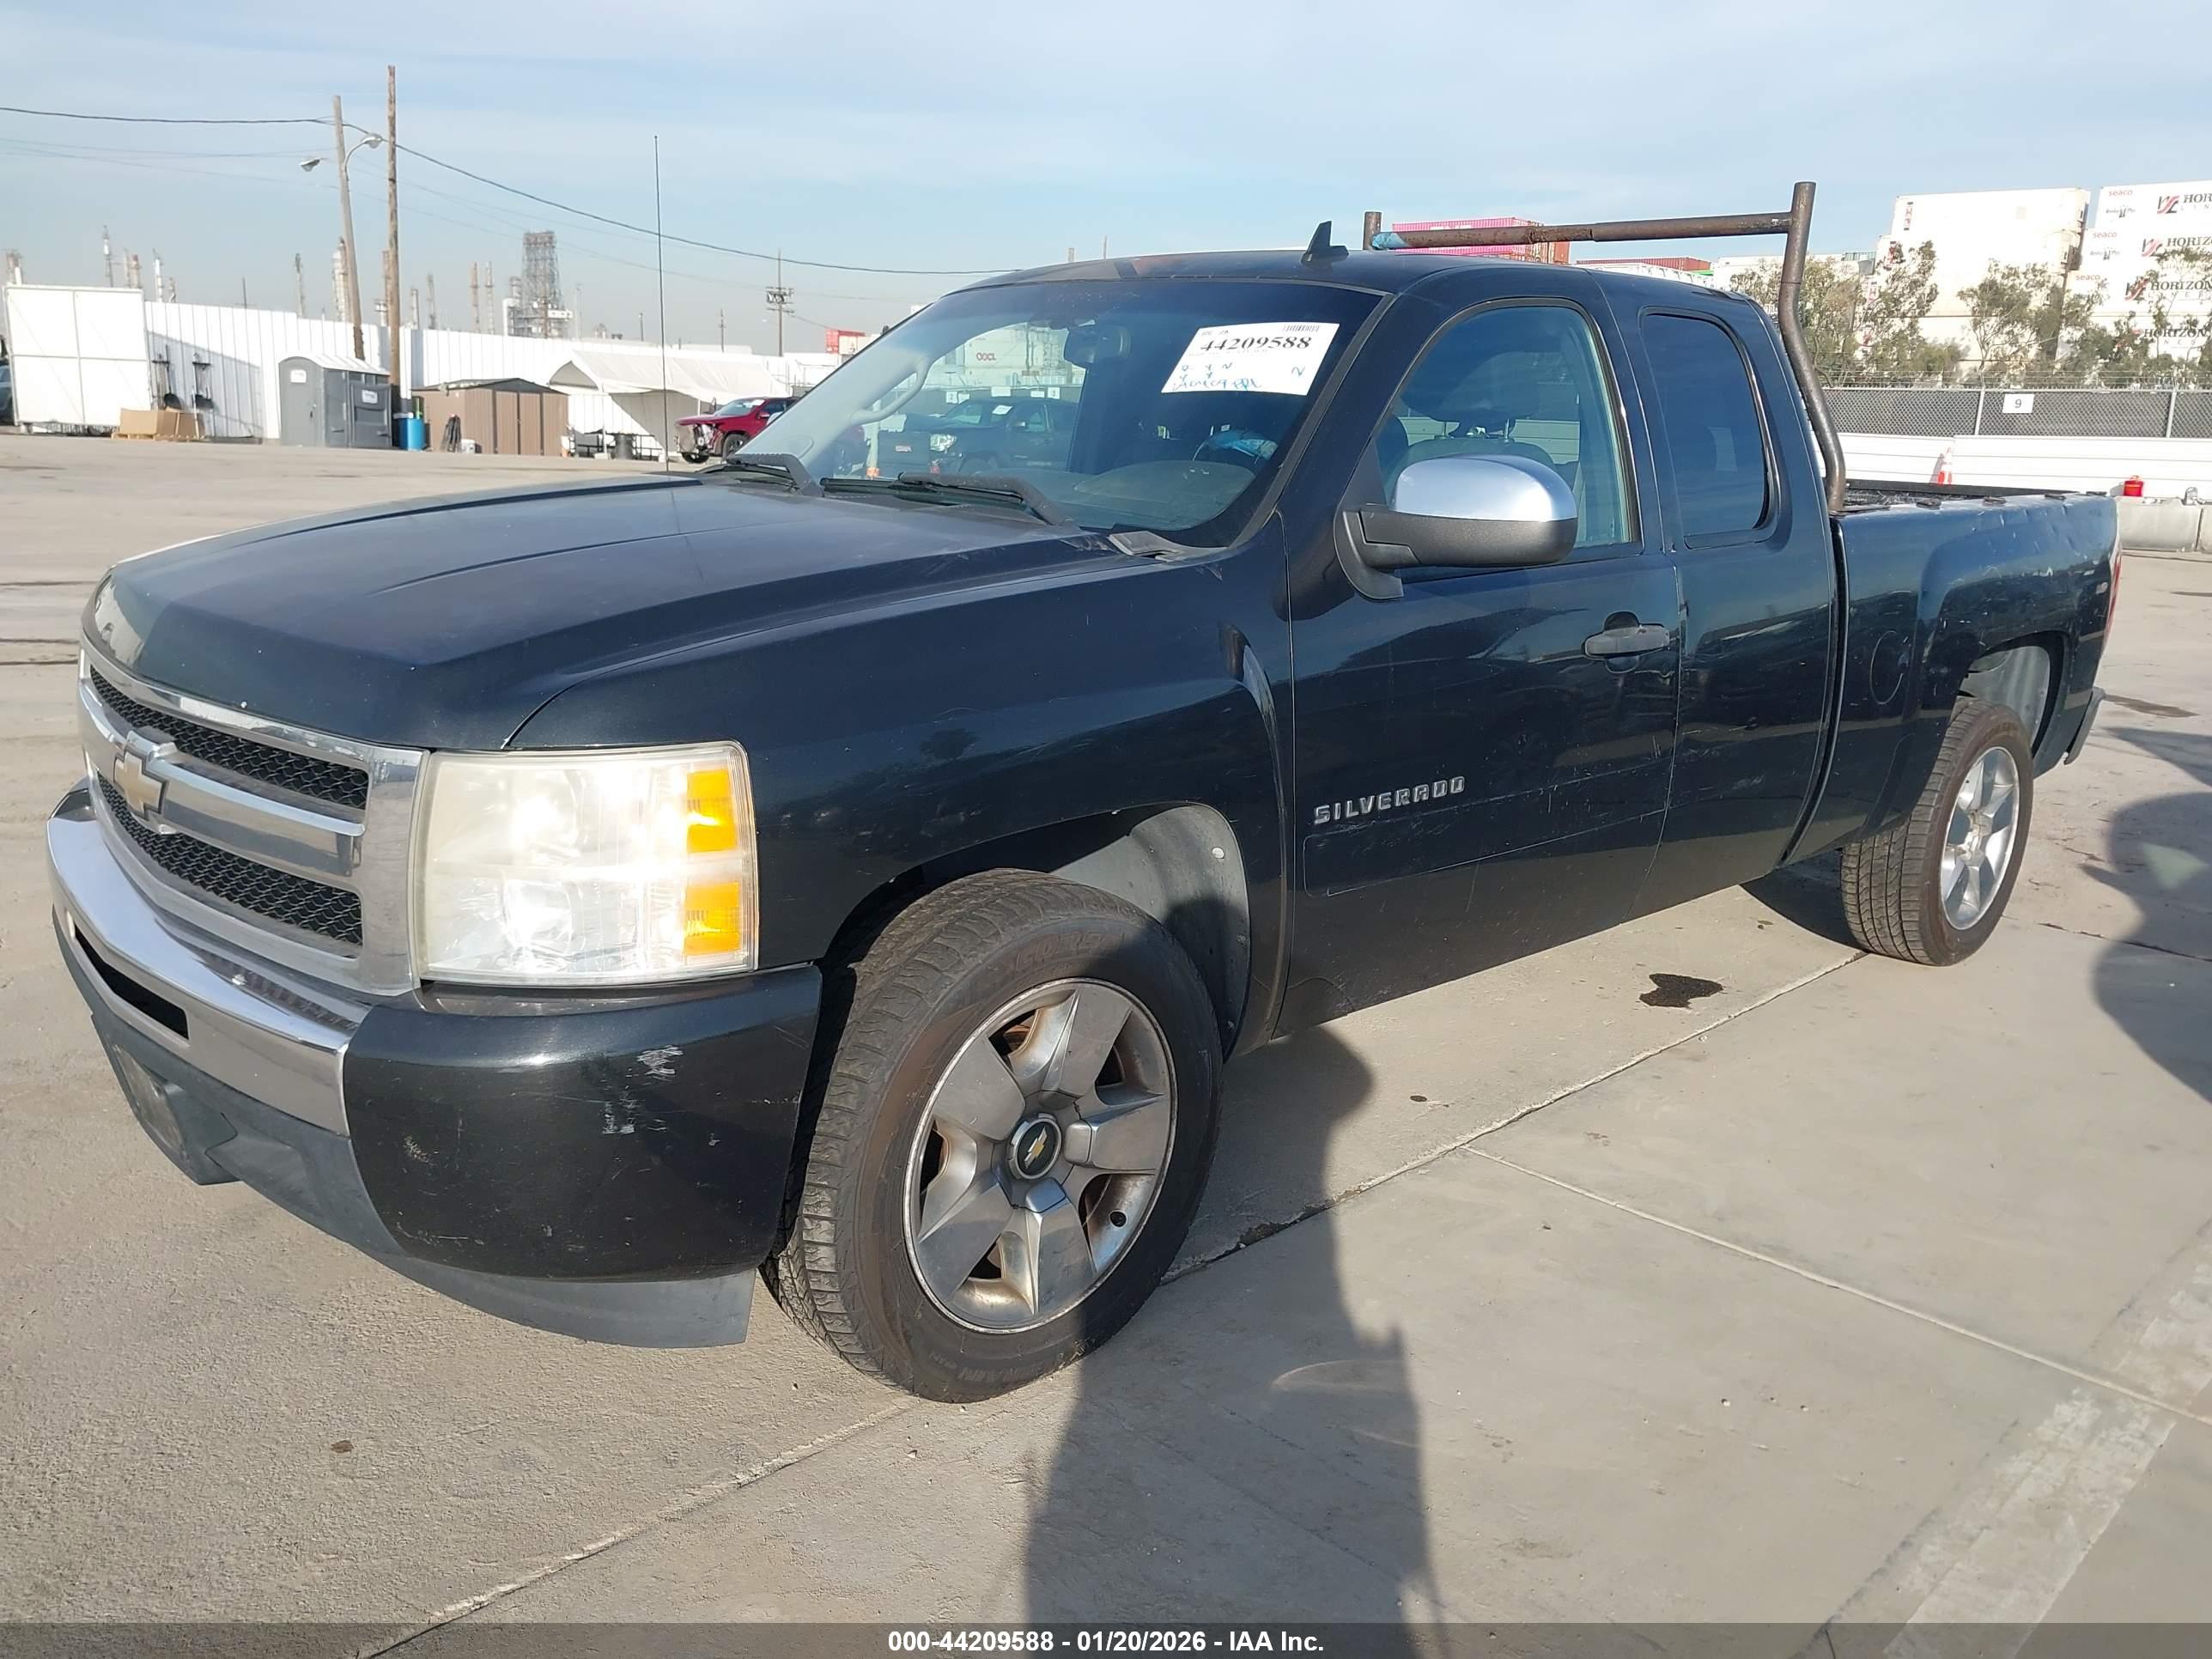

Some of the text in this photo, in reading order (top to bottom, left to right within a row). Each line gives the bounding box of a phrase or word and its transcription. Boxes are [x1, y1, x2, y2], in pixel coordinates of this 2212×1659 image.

[2108, 188, 2133, 197] seaco
[2166, 236, 2212, 247] HORIZ
[1200, 336, 1312, 351] 44209588
[975, 351, 997, 362] OOCL
[2014, 398, 2022, 409] 9
[1314, 775, 1466, 825] SILVERADO
